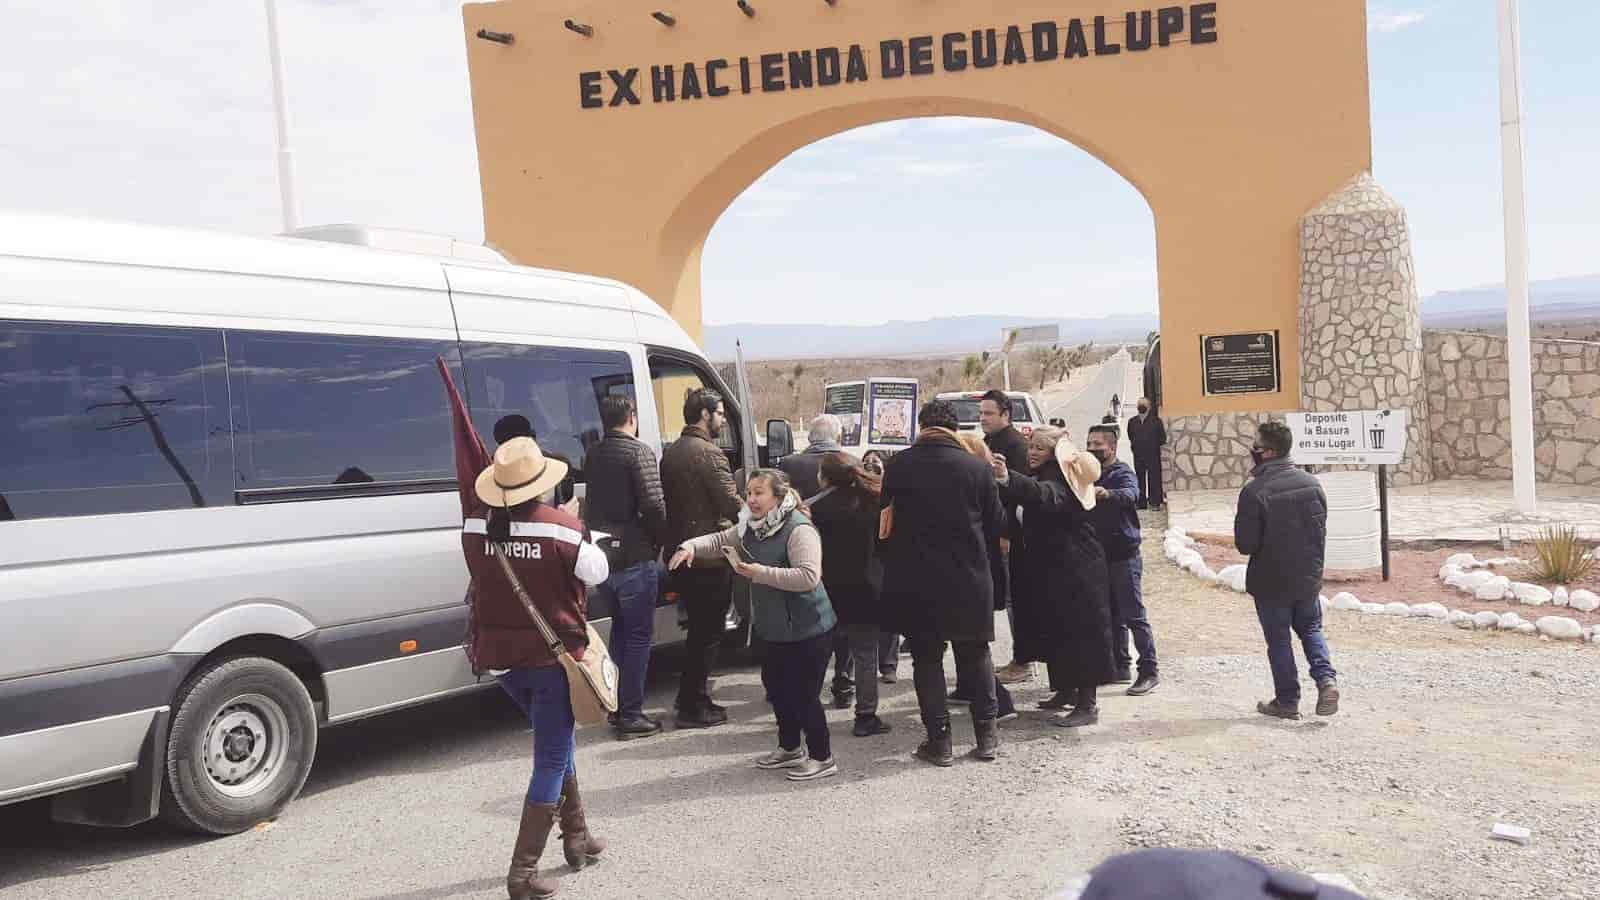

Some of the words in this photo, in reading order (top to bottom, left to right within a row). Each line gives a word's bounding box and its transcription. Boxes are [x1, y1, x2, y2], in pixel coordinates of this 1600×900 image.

[580, 68, 640, 108] EX
[651, 45, 868, 102] HACIENDA
[1304, 413, 1348, 424] Deposite
[1304, 426, 1313, 435] la
[1315, 425, 1350, 435] Basura
[1299, 440, 1311, 448] en
[1312, 440, 1326, 448] su
[1328, 439, 1356, 450] Lugar
